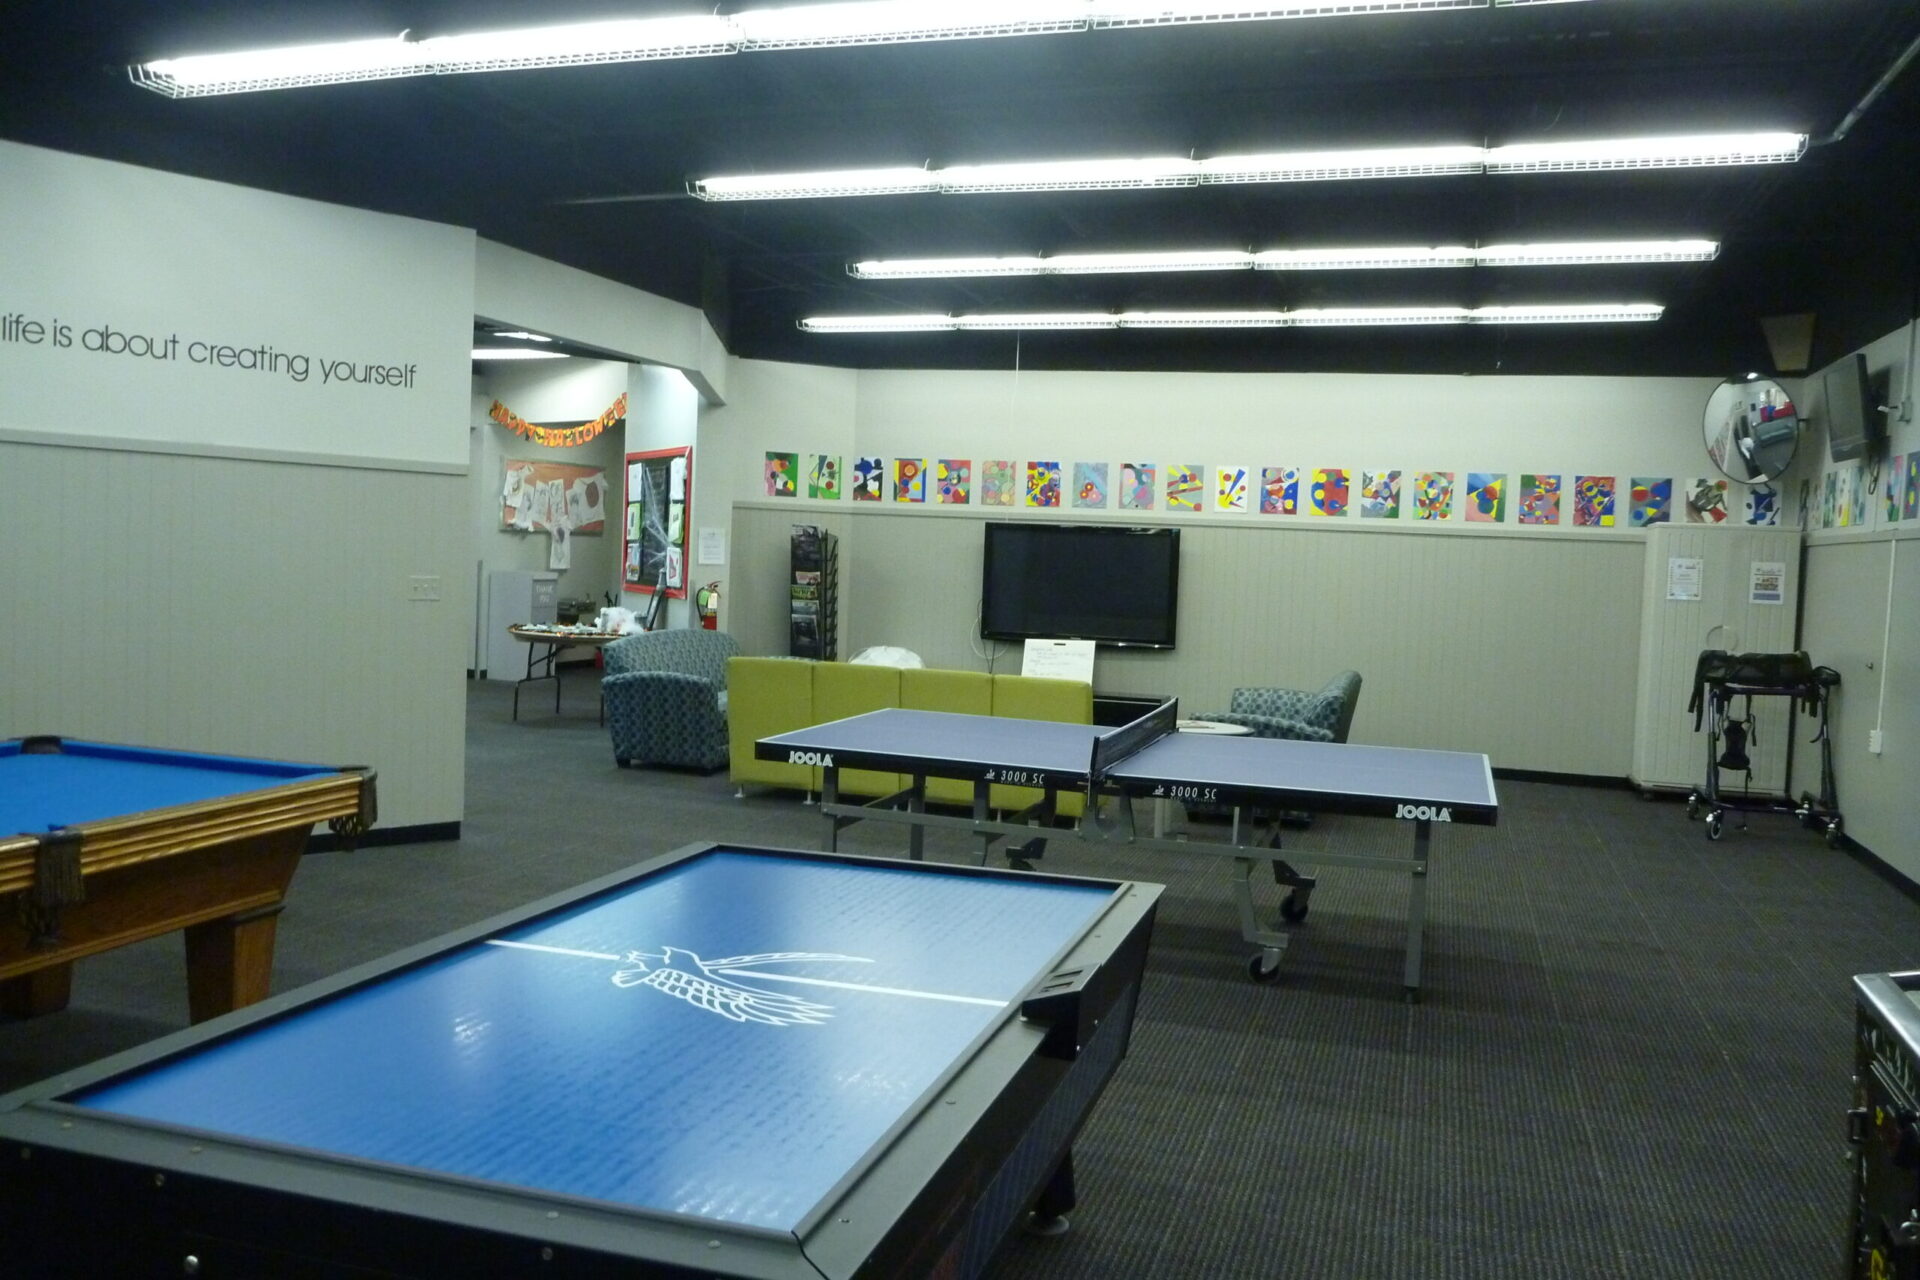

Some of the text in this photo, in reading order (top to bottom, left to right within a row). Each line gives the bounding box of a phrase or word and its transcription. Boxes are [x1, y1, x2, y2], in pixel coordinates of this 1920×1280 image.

[2, 313, 417, 389] life is about creating yourself
[542, 391, 627, 448] HALLOWEE
[788, 750, 834, 767] JOOLA
[1000, 769, 1027, 783] 3000
[1032, 772, 1046, 785] SC
[1170, 785, 1198, 798] 3000
[1204, 787, 1217, 800] SC
[1395, 803, 1452, 823] JOOLA
